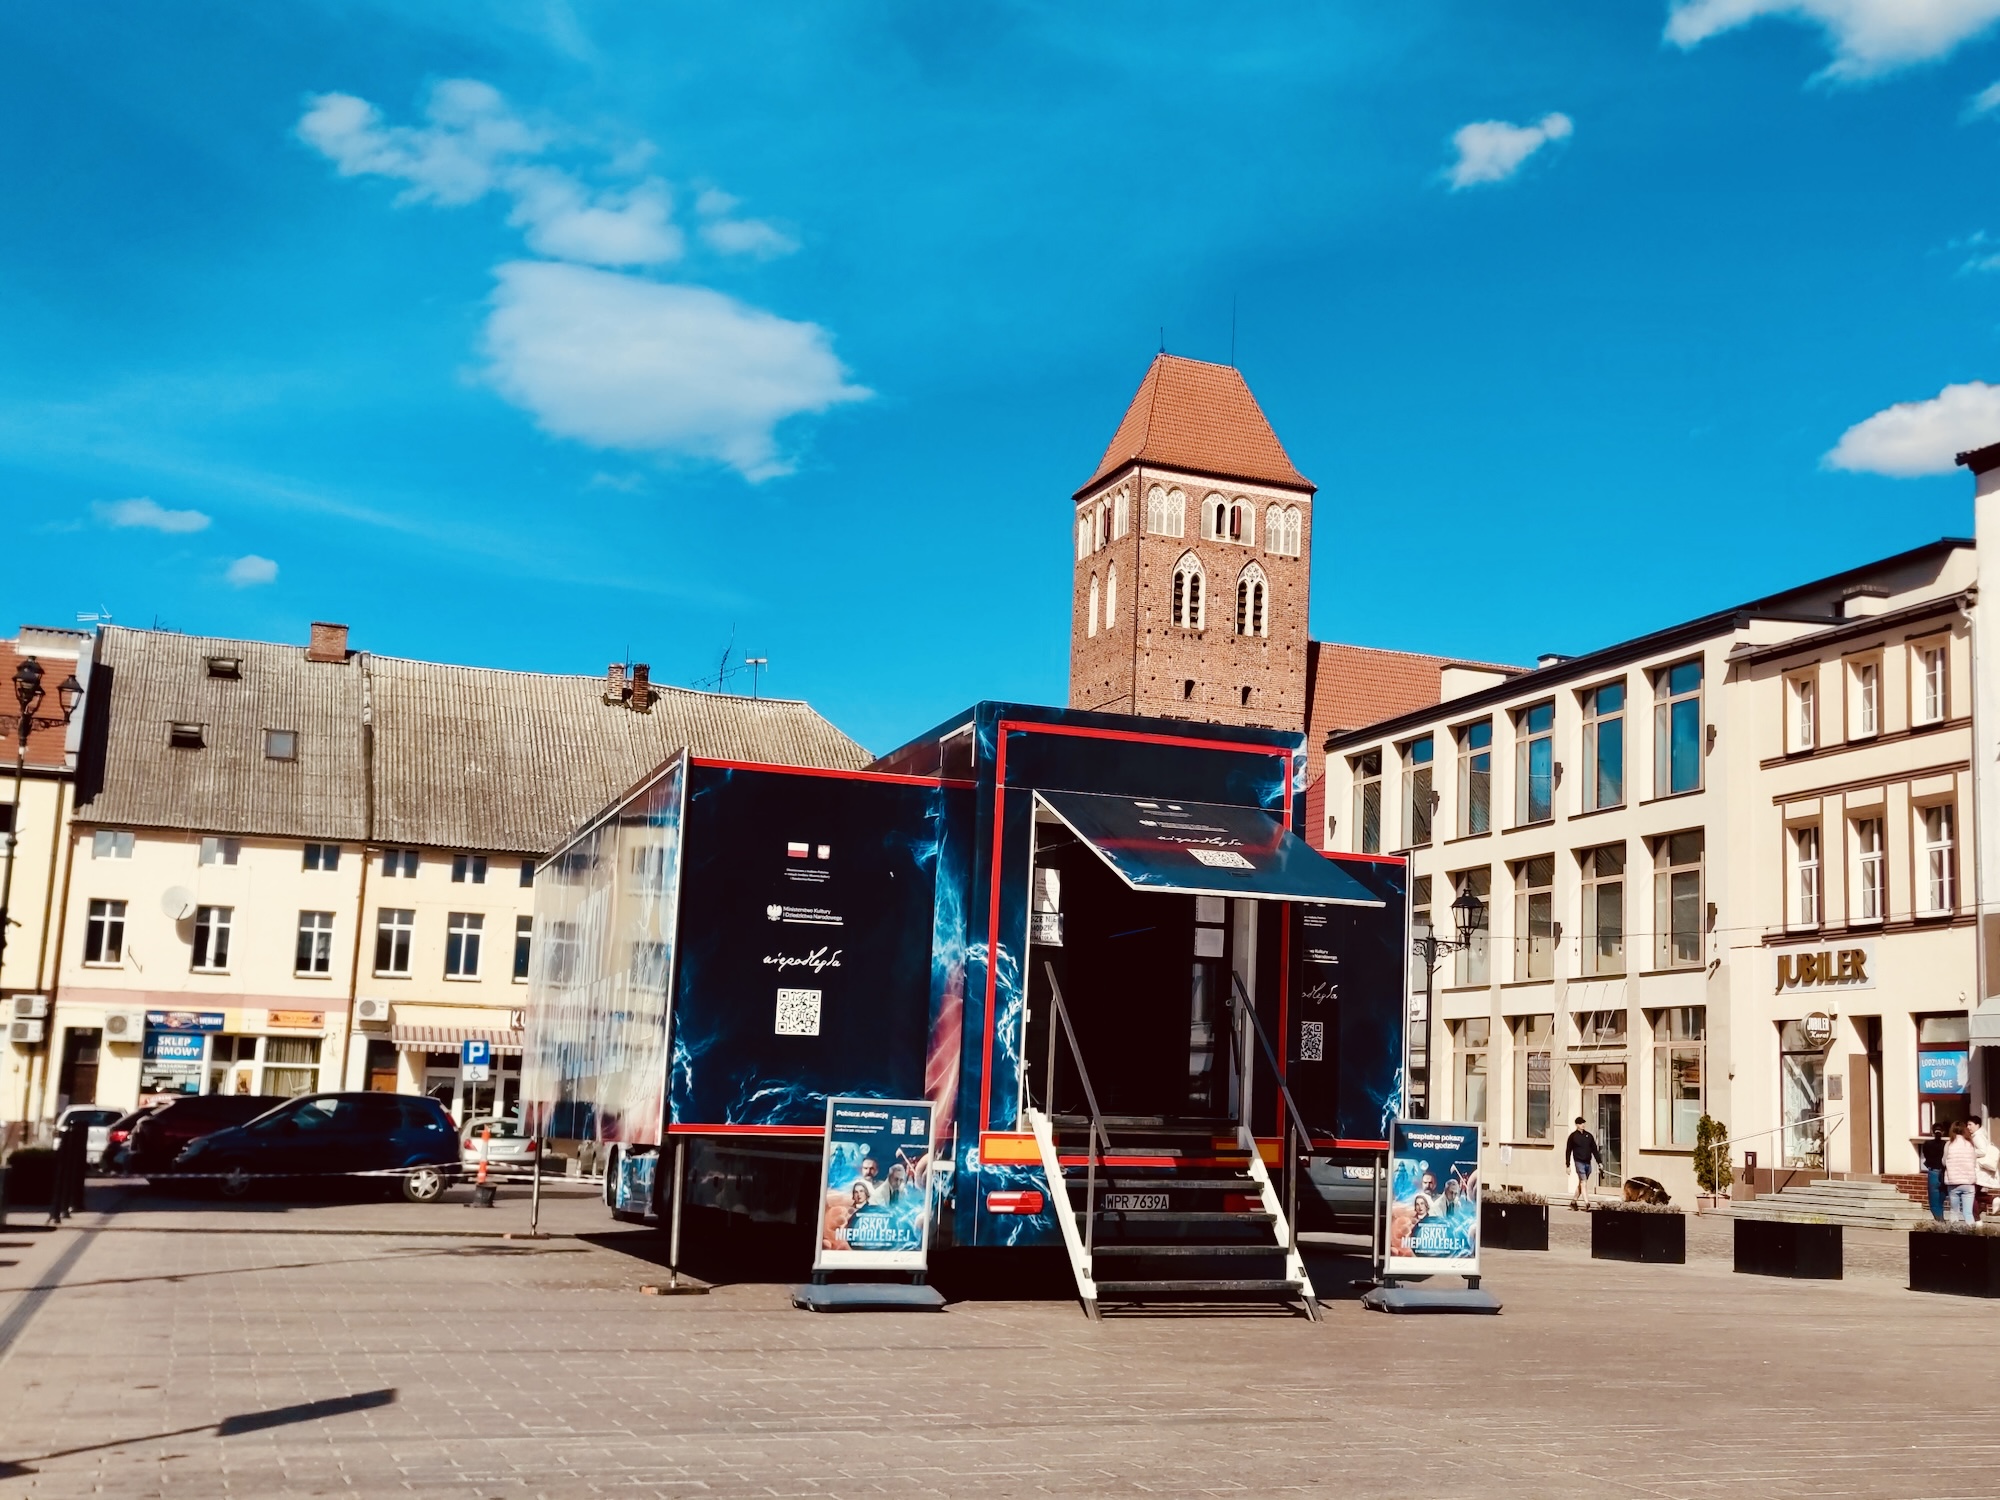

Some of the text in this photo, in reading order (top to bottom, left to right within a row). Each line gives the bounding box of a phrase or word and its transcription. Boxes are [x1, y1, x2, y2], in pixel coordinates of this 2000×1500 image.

[1775, 949, 1868, 995] JUBILER
[1807, 1018, 1830, 1031] JUBILER
[158, 1036, 191, 1047] SKLEP
[147, 1045, 200, 1056] FIRMOWY
[468, 1041, 485, 1063] P
[1931, 1069, 1947, 1078] LODY
[836, 1109, 889, 1119] Pobierz Aplikację
[1441, 1135, 1465, 1143] pokazy
[1423, 1141, 1434, 1150] pół
[1434, 1142, 1460, 1151] godziny
[1106, 1195, 1168, 1209] WPR 7639A
[859, 1217, 890, 1229] ISKRY
[1420, 1227, 1448, 1239] ISKRY
